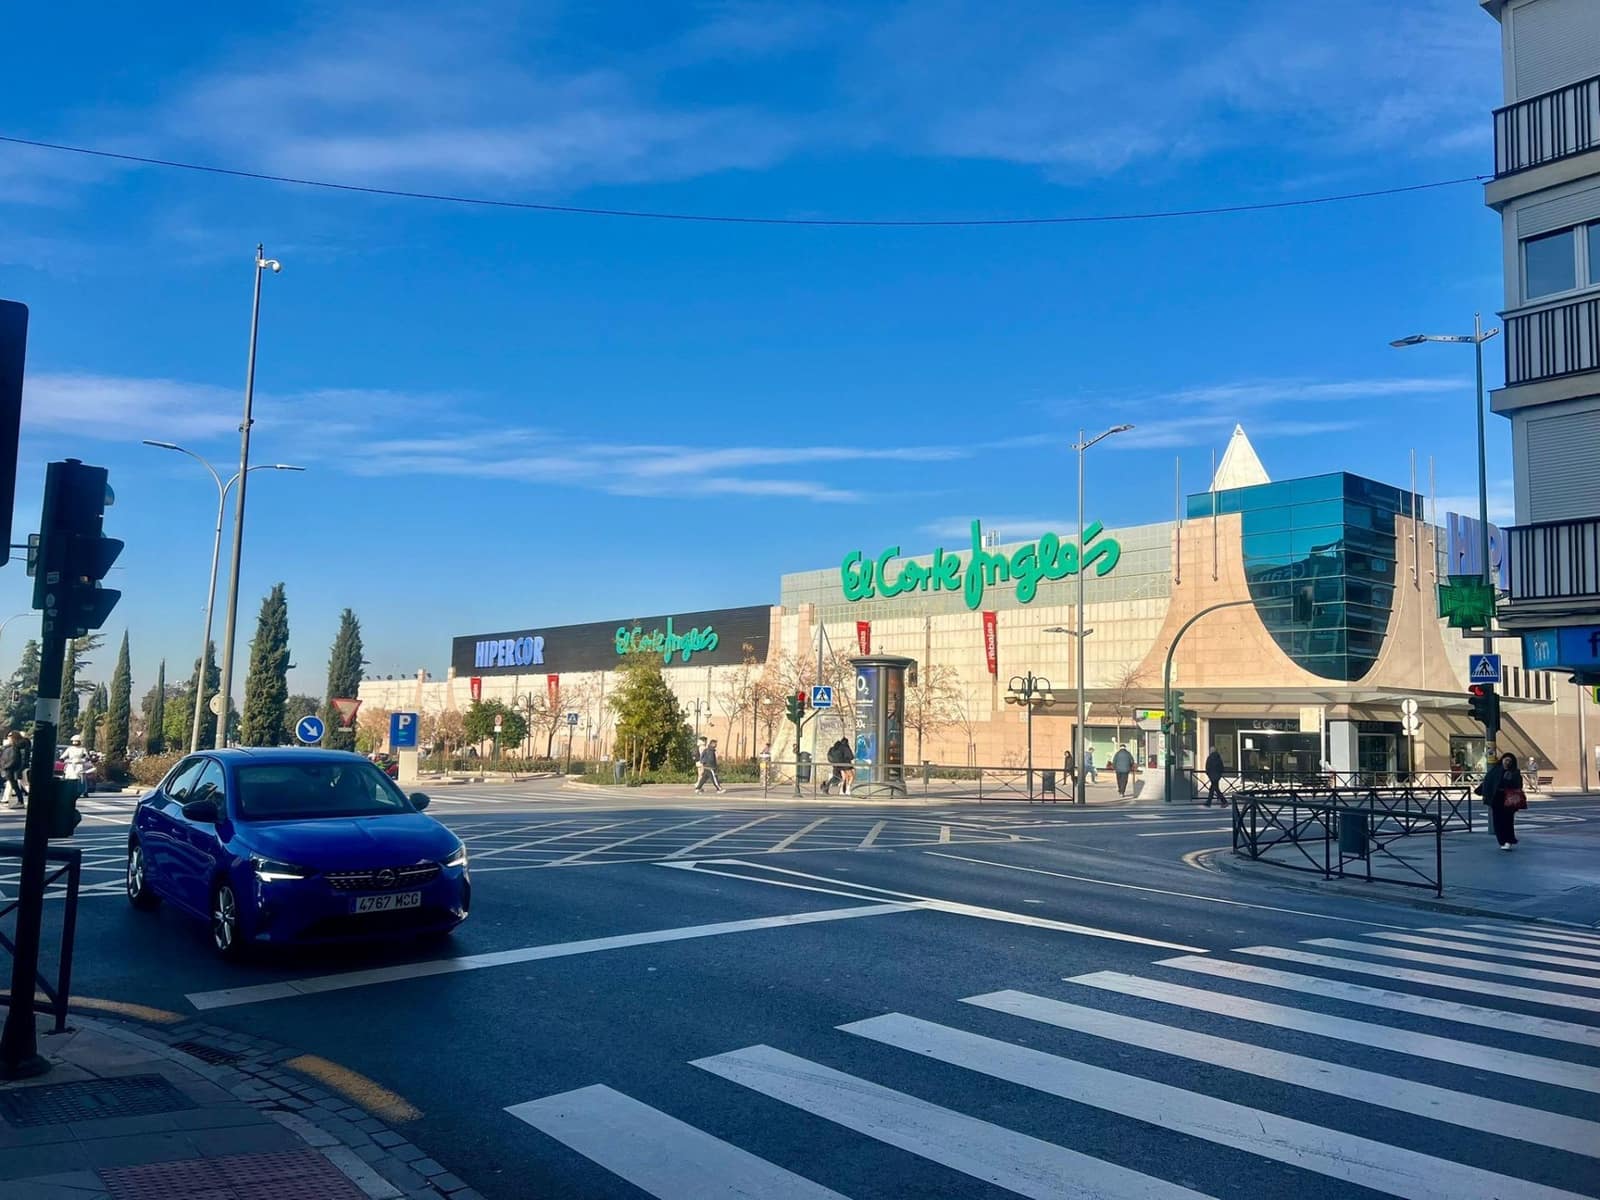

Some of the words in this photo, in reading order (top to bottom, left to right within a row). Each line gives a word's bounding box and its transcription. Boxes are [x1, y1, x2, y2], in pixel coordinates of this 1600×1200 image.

[842, 550, 874, 601] El
[877, 546, 960, 597] Corte
[475, 636, 545, 668] HIPERCOR
[615, 626, 630, 655] El
[664, 616, 719, 664] Inglés
[399, 715, 411, 729] P
[359, 896, 392, 912] 4767
